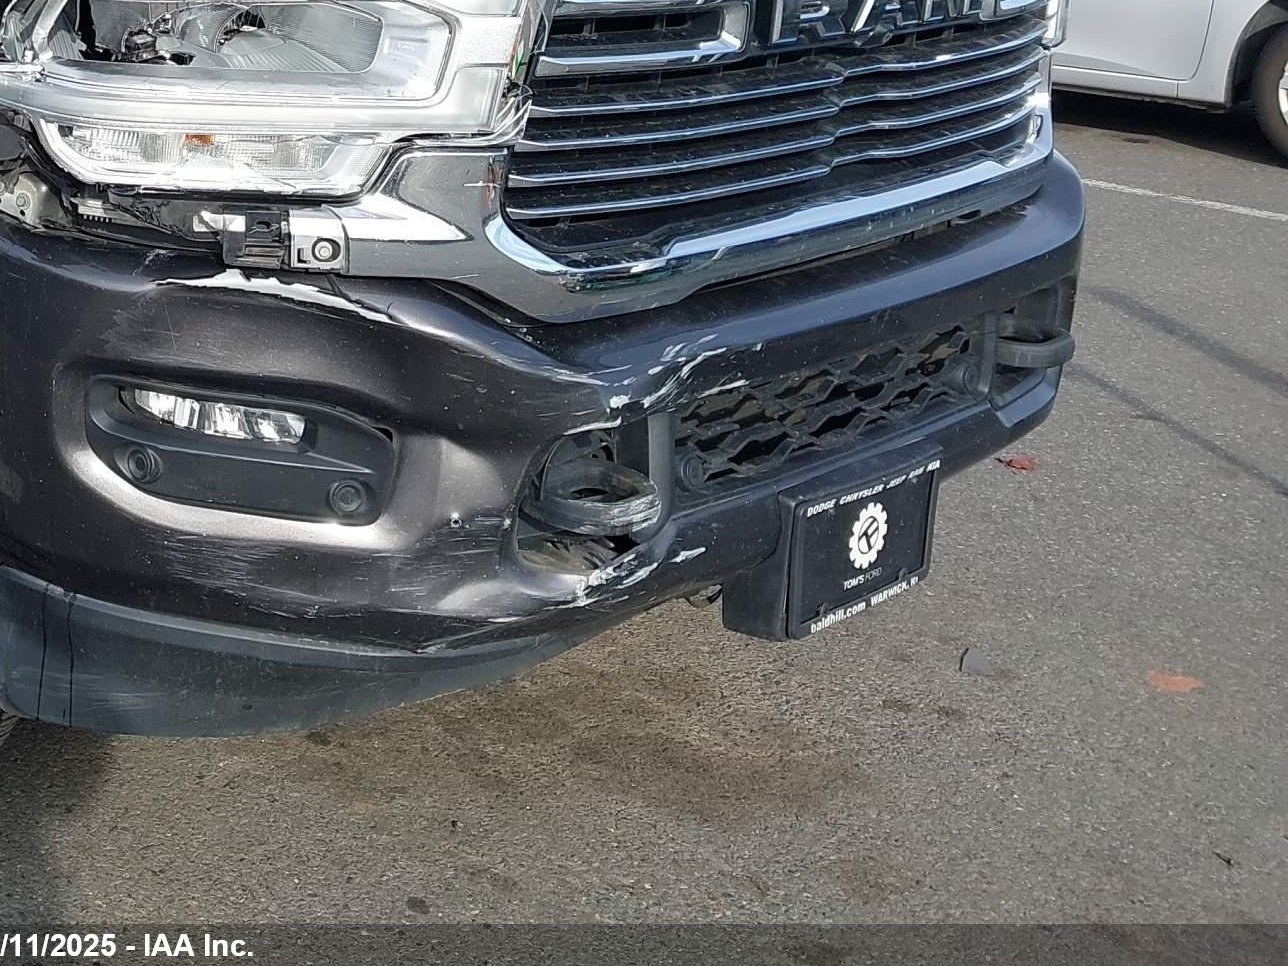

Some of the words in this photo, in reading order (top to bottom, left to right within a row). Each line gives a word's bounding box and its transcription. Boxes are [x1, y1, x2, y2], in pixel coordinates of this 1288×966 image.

[806, 498, 837, 518] DODGE
[839, 484, 885, 505] CHRYSLER
[886, 474, 907, 489] JEEP
[926, 459, 941, 472] KIA
[864, 567, 883, 582] FORD
[810, 601, 866, 634] baldhill.com
